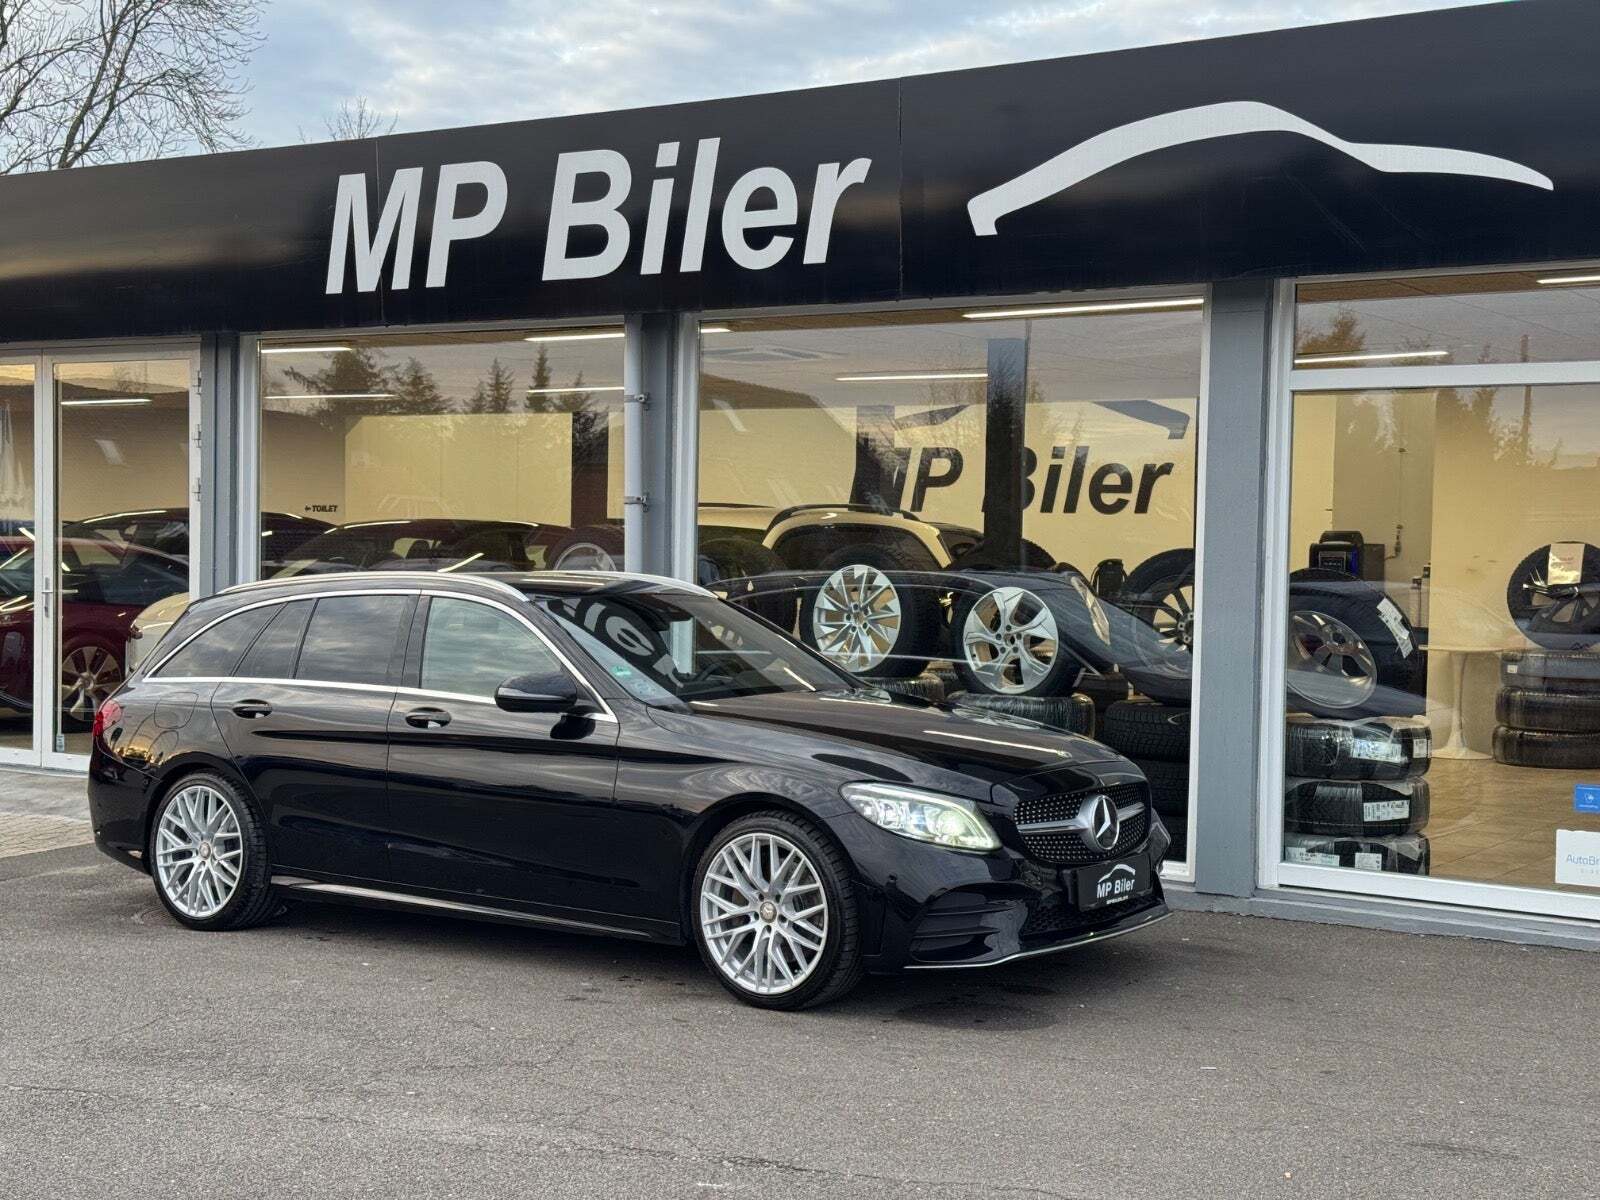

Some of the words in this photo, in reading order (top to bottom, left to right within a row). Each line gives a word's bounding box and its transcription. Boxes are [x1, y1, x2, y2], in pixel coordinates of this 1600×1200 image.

[325, 160, 508, 295] MP
[541, 137, 872, 282] Biler
[849, 446, 964, 513] P
[312, 504, 338, 512] TOILET
[1097, 882, 1112, 898] MP
[1114, 878, 1135, 894] Biler
